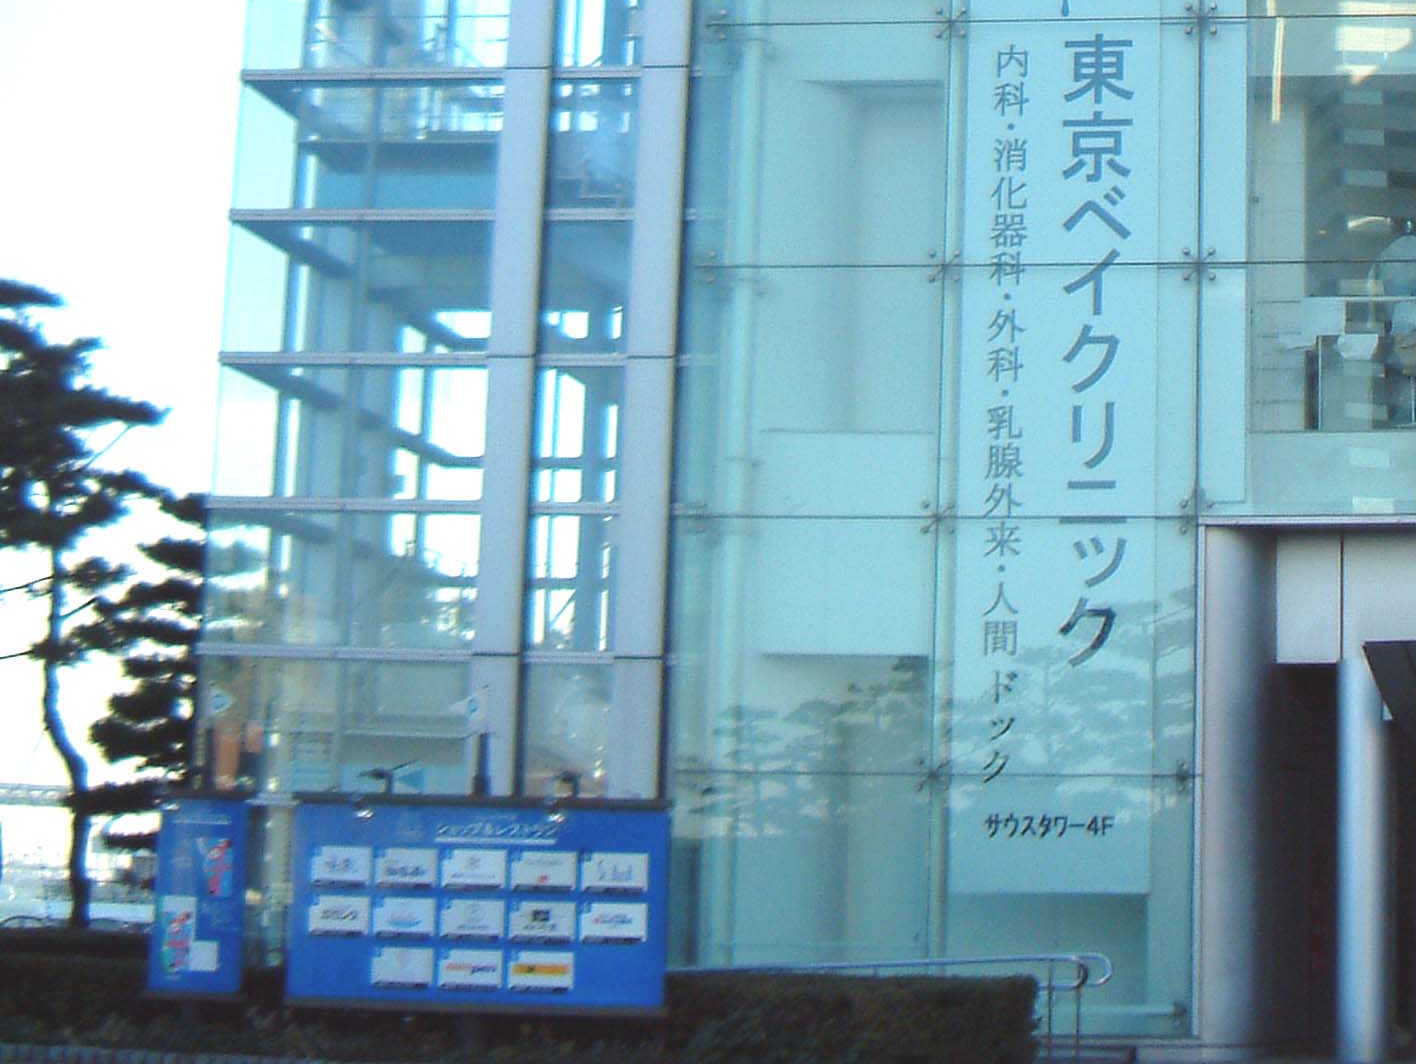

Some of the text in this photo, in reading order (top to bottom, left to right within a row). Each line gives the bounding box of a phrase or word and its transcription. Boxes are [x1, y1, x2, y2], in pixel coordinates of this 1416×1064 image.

[1058, 33, 1135, 668] 東京ベイクリニック
[983, 813, 1116, 840] サウスタワー4F
